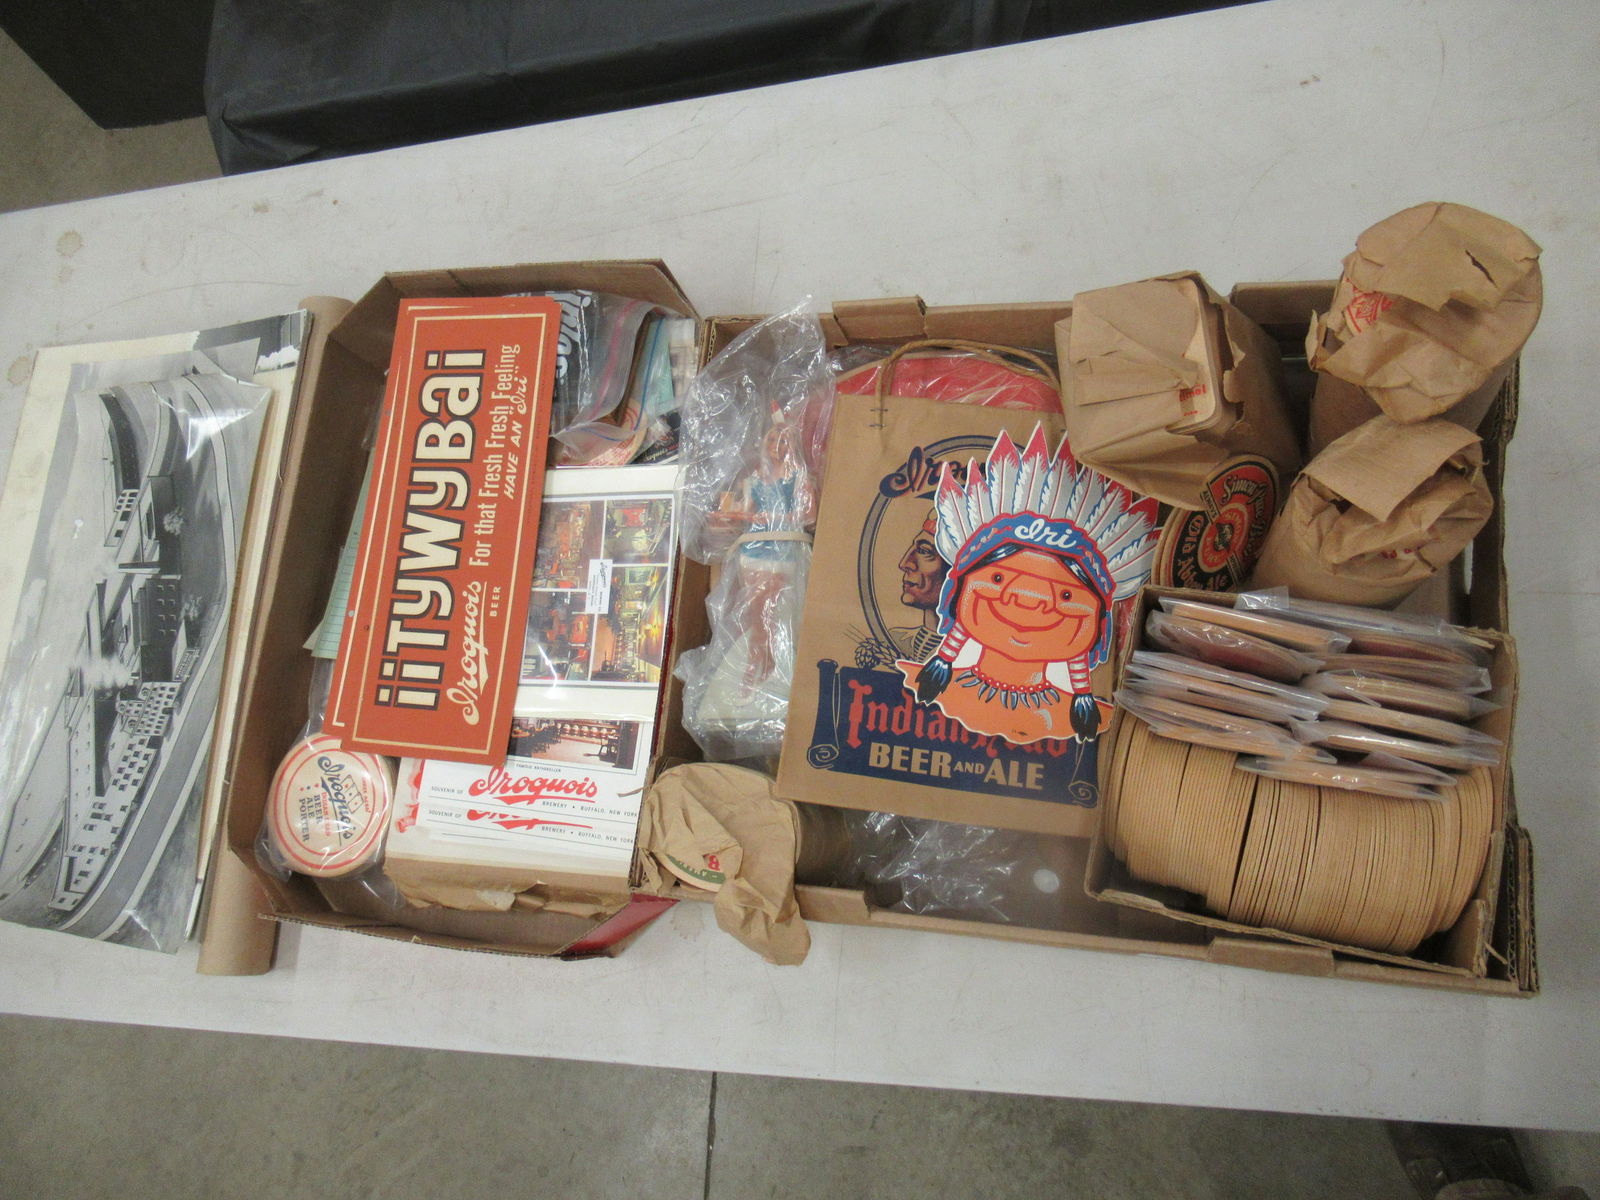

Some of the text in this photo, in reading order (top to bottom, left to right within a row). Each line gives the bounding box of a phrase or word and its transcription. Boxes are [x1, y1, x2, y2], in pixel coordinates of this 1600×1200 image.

[469, 344, 520, 566] For that Fresh Fresh Feeling
[504, 452, 518, 499] HAVE
[511, 420, 523, 448] AN
[1014, 518, 1077, 549] Iri
[489, 585, 501, 617] BEER
[446, 580, 489, 725] Iroquois
[868, 741, 952, 778] BEER
[953, 760, 985, 775] AND
[983, 758, 1045, 790] ALE
[317, 756, 356, 840] Iroquois
[431, 786, 456, 795] SOUVENIR
[468, 764, 598, 805] Iroquois
[299, 798, 309, 841] PORTER
[305, 797, 315, 819] ALE
[314, 795, 323, 824] BEER
[428, 810, 454, 819] SOUVENIR
[542, 801, 568, 809] BREWERY
[608, 808, 621, 816] NEW
[541, 826, 566, 834] BREWERY
